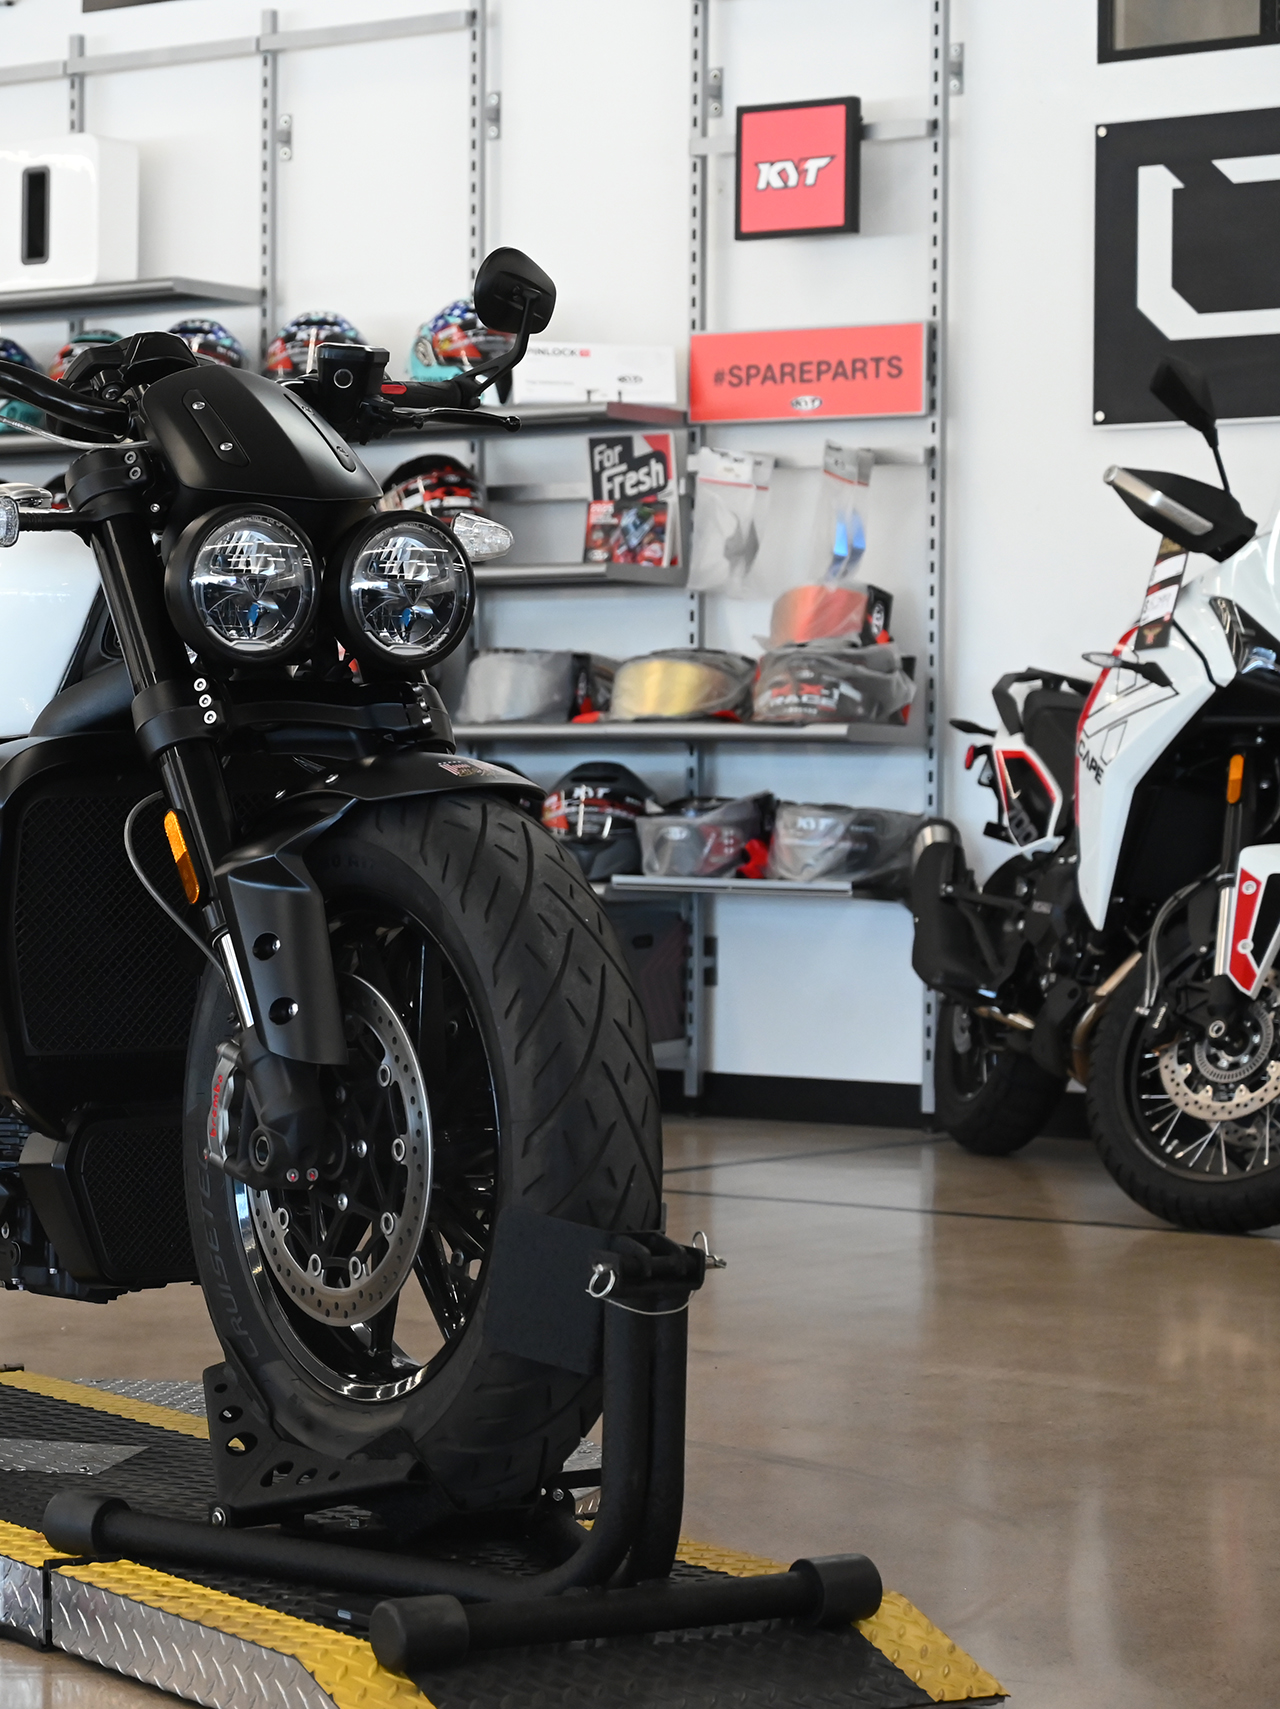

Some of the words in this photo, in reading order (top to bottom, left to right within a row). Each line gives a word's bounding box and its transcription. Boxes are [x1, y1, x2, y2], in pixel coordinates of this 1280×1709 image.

[754, 155, 837, 192] KYT
[714, 356, 904, 388] #SPAREPARTS
[593, 443, 623, 473] For
[601, 457, 665, 501] Fresh
[210, 1074, 224, 1138] brembo
